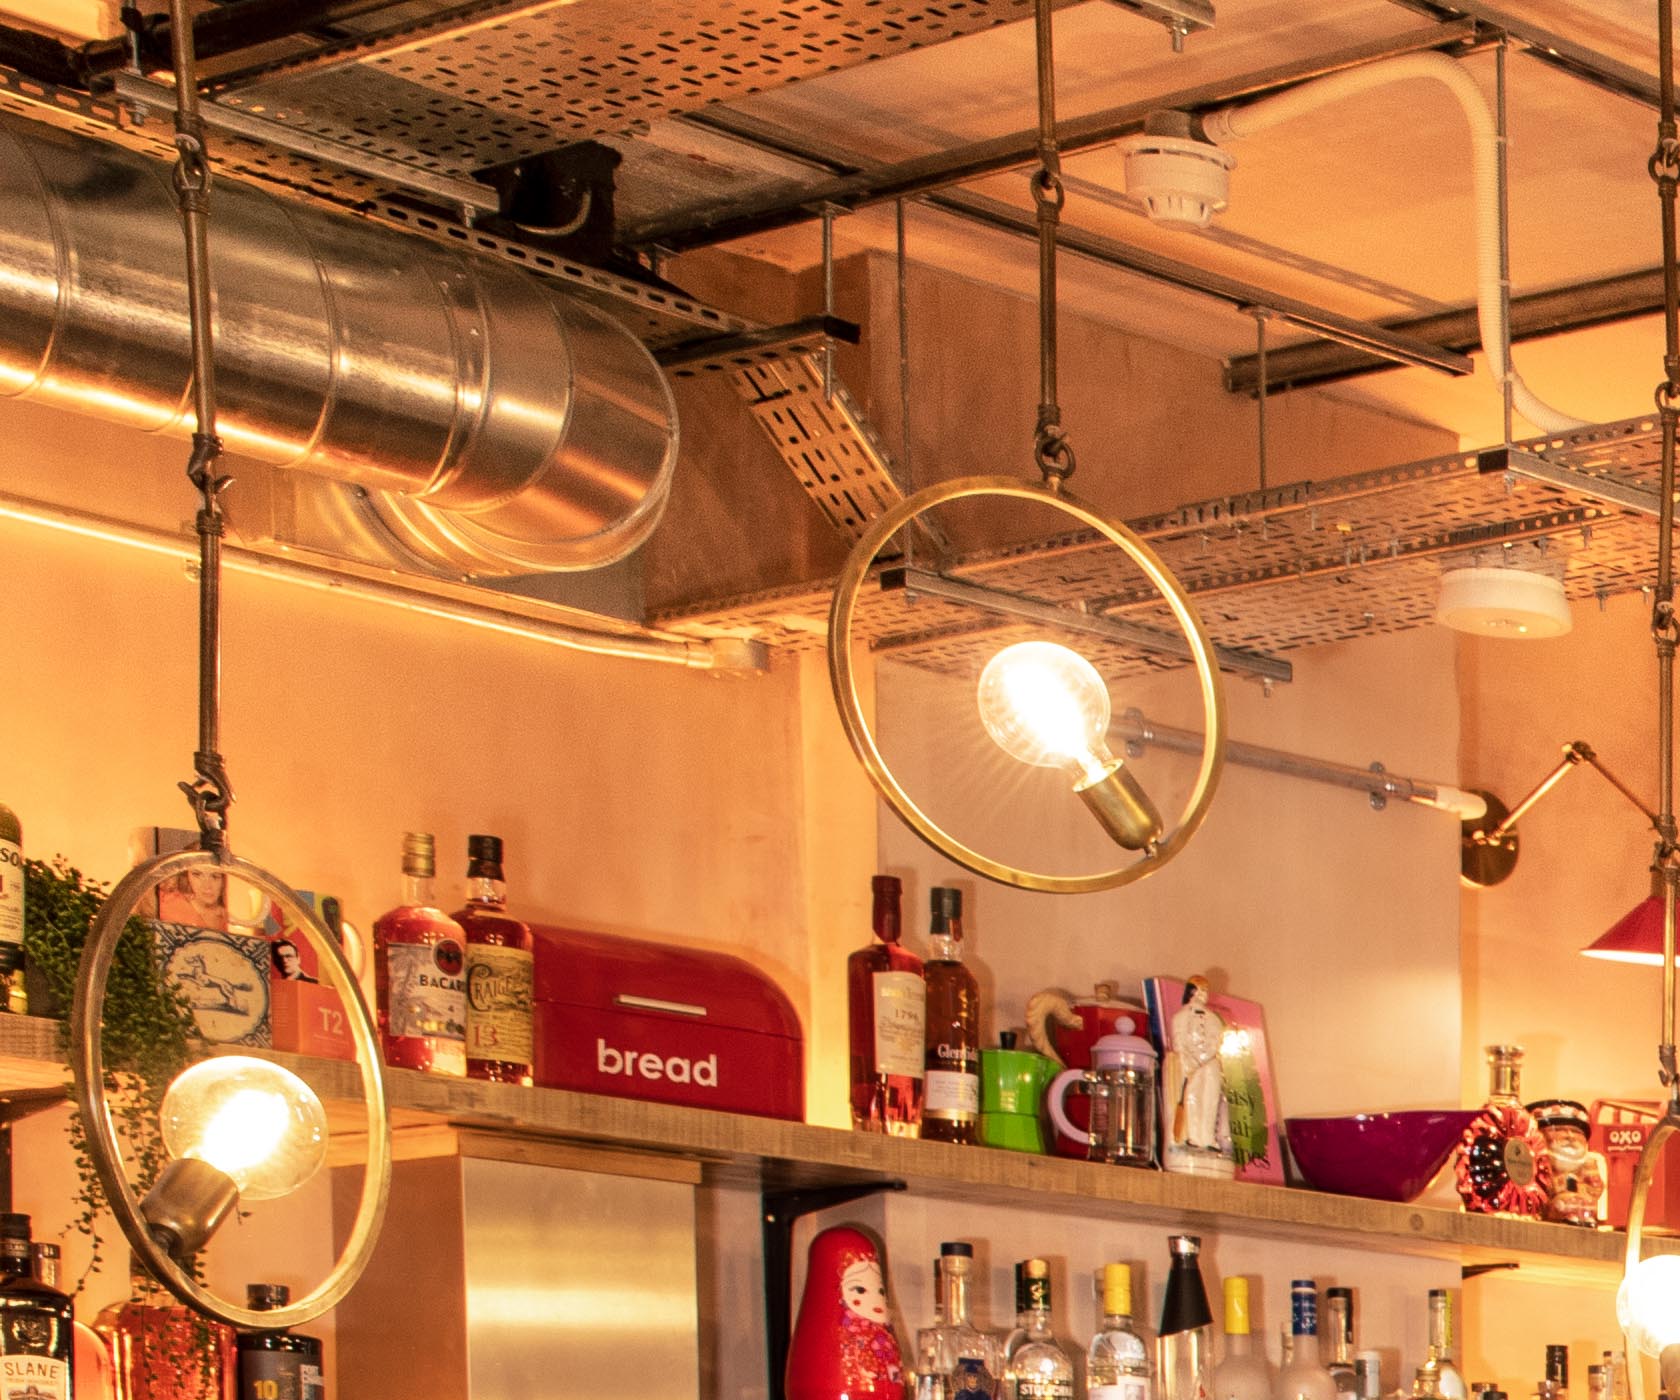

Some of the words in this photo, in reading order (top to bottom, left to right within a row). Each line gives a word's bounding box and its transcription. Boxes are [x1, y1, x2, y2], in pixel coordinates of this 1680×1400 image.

[318, 1007, 344, 1034] T2
[597, 1037, 718, 1088] bread
[1609, 1130, 1641, 1145] OXO
[4, 1361, 59, 1380] SLANE
[253, 1379, 279, 1400] 10
